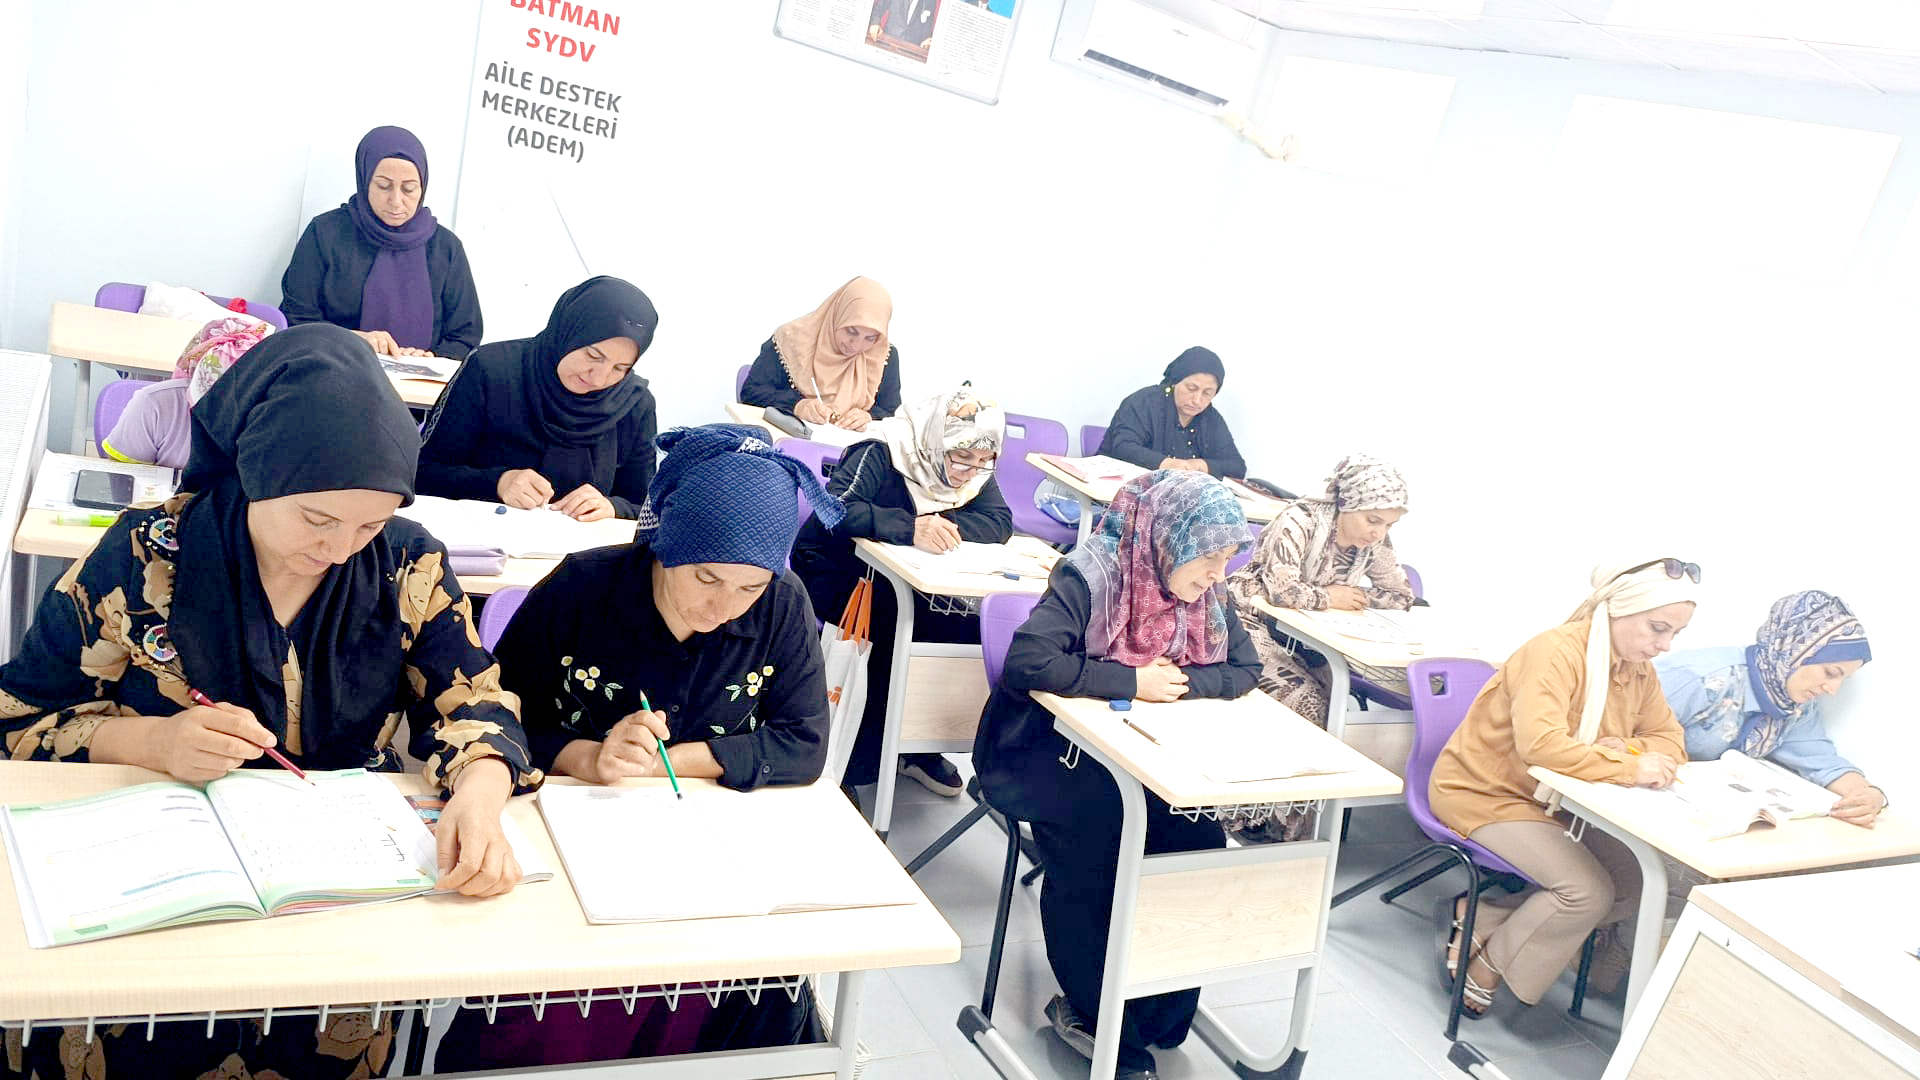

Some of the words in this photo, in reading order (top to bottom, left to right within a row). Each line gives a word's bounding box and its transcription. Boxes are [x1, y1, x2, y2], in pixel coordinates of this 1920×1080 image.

[527, 28, 596, 62] SYDV
[485, 61, 533, 90] AİLE
[540, 77, 621, 112] DESTEK
[482, 90, 617, 139] MERKEZLERİ
[508, 126, 583, 163] (ADEM)
